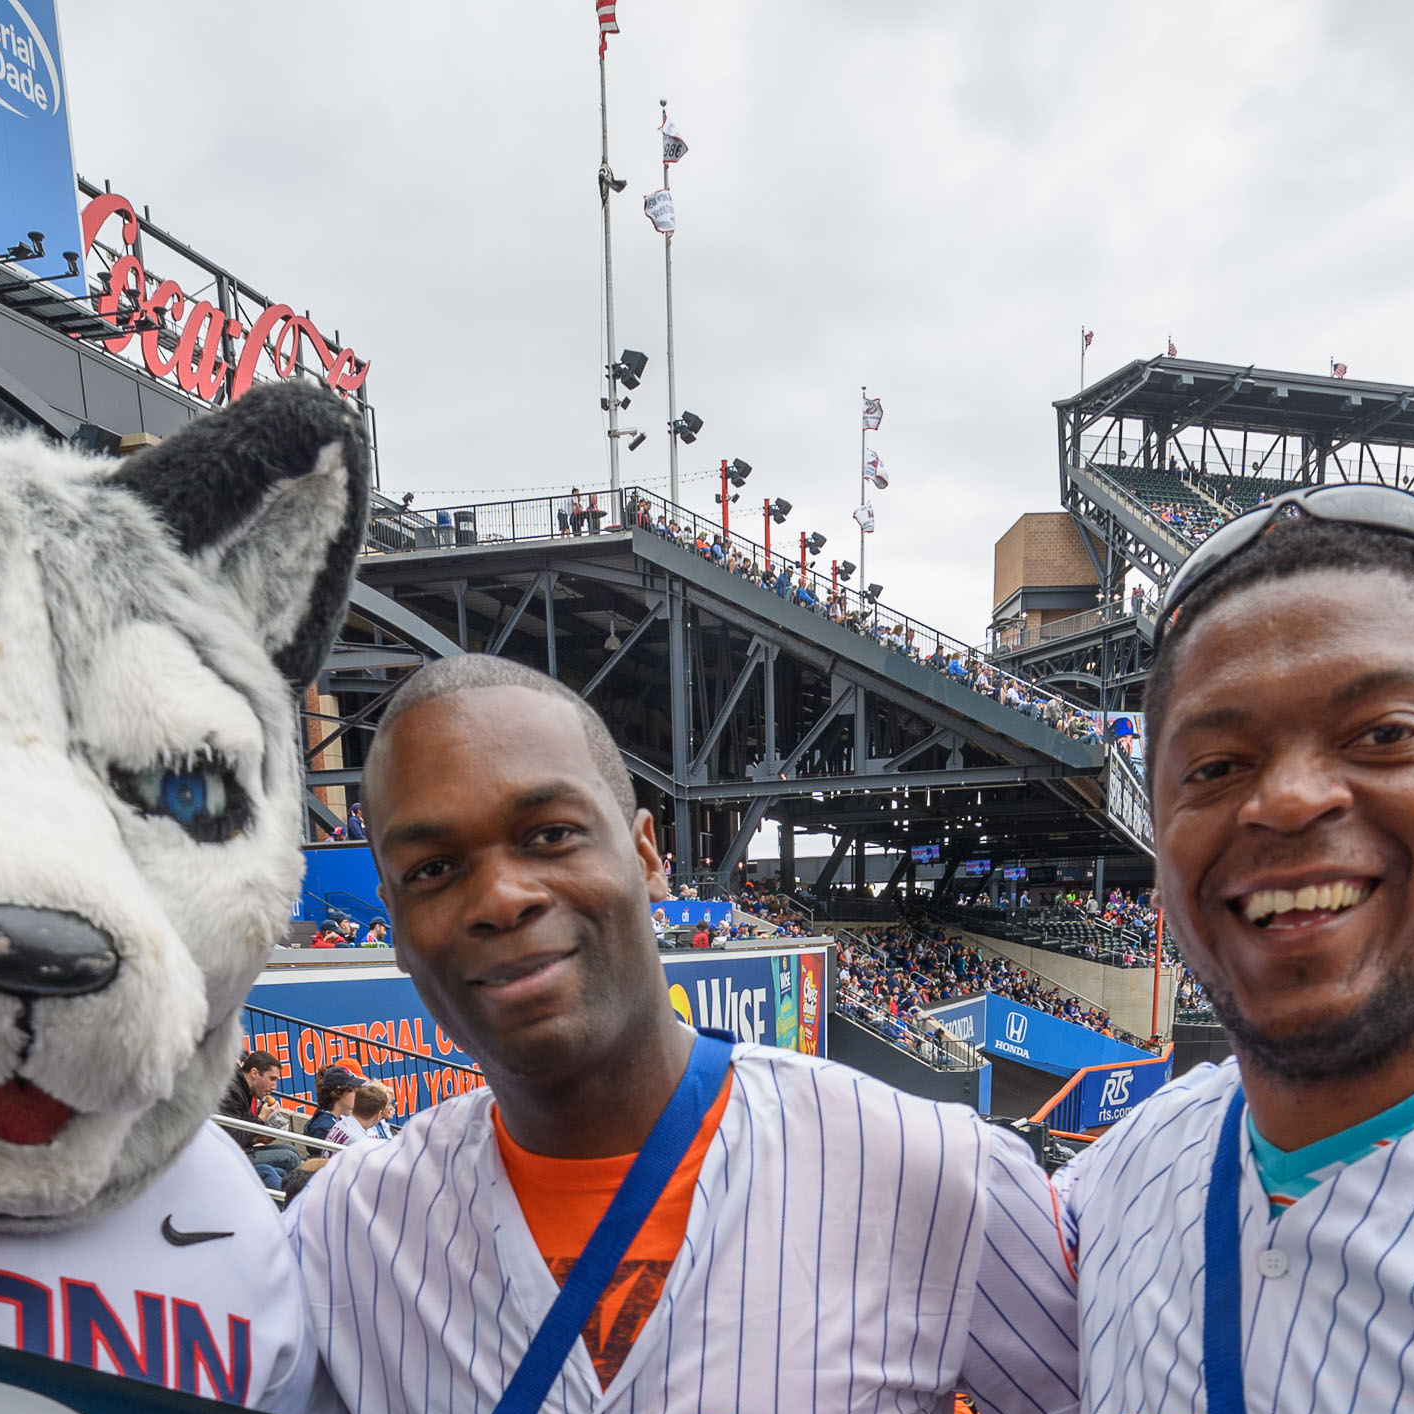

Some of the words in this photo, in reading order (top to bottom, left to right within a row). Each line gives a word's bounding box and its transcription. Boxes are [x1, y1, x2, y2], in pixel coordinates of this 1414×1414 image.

[297, 1017, 432, 1076] OFFICIAL
[994, 1039, 1031, 1059] HONDA
[1099, 1069, 1135, 1108] RTS
